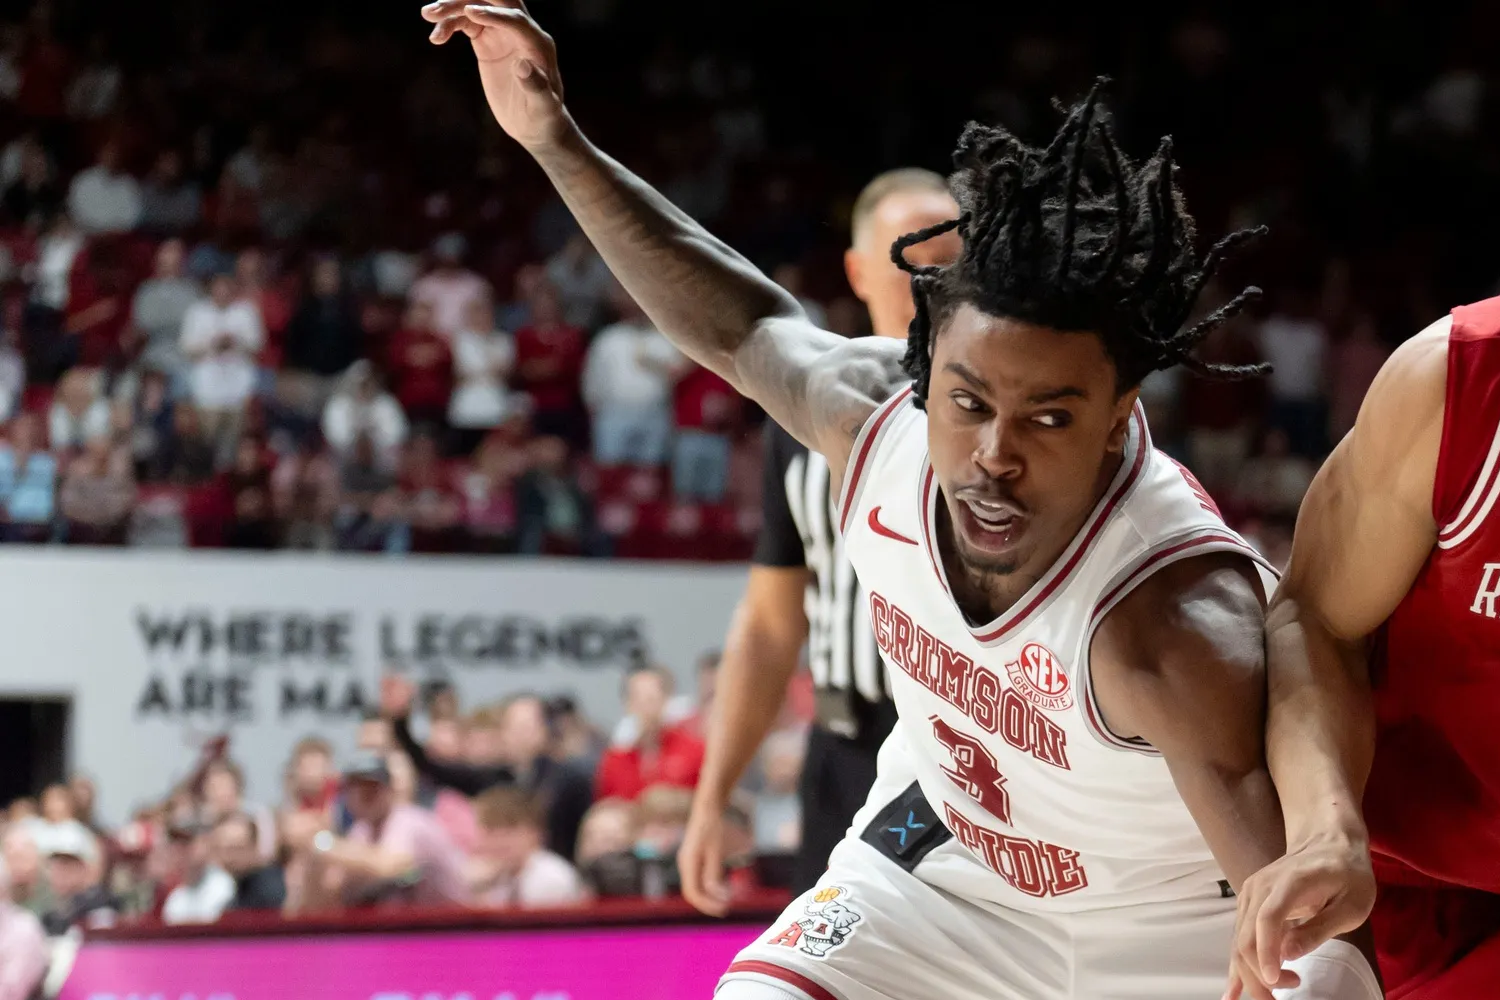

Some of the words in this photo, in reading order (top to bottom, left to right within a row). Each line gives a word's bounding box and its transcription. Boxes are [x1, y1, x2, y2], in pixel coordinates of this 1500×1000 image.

[136, 607, 351, 657] WHERE
[379, 611, 646, 668] LEGENDS
[136, 671, 252, 718] ARE
[870, 590, 1071, 771] CRIMSON
[1013, 675, 1067, 709] GRADUATE
[1022, 644, 1066, 694] SEC
[928, 714, 1013, 827] 3
[943, 801, 1088, 898] TIDE
[767, 921, 803, 947] A
